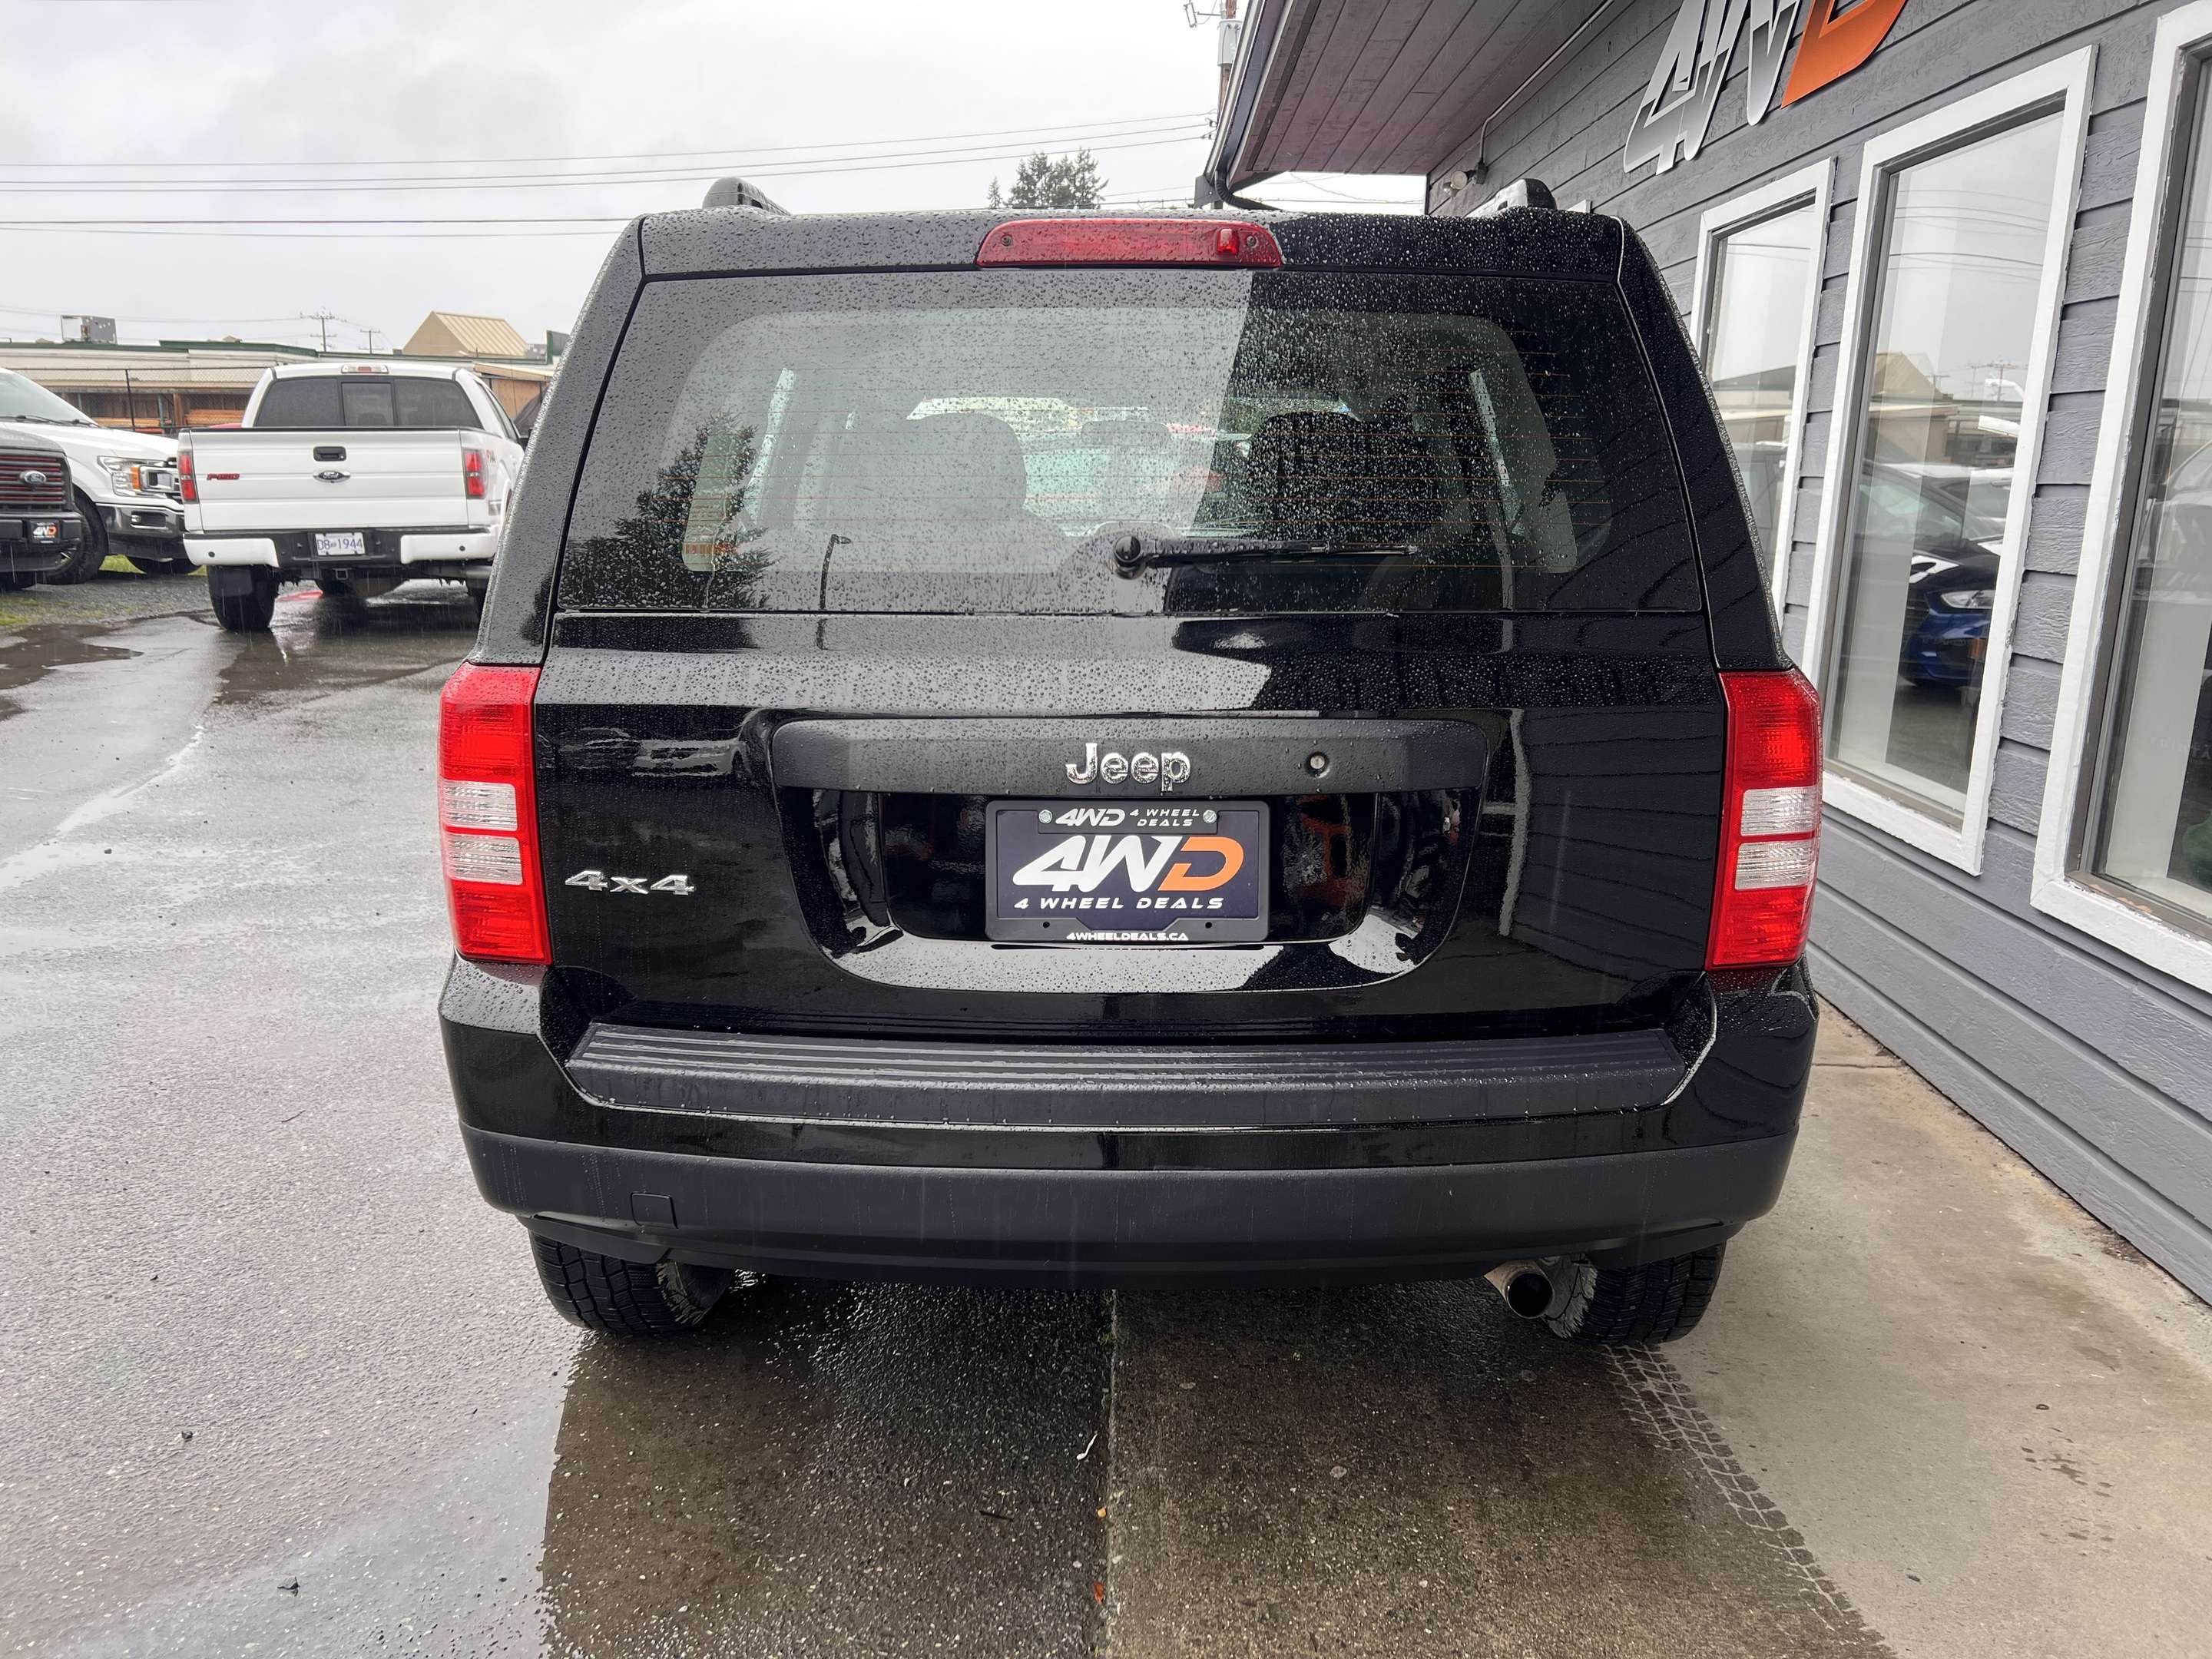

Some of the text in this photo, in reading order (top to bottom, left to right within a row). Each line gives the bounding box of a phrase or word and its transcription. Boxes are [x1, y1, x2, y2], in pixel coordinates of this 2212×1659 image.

[338, 538, 363, 549] 1944
[1065, 742, 1191, 793] Jeep
[1055, 808, 1126, 827] 4WD
[1137, 819, 1193, 827] DEALS
[1012, 834, 1245, 893] 4WD
[565, 870, 695, 896] 4x4
[1014, 897, 1224, 909] 4 WHEEL DEALS
[1065, 932, 1189, 942] 4WHEELDEALS.CA
